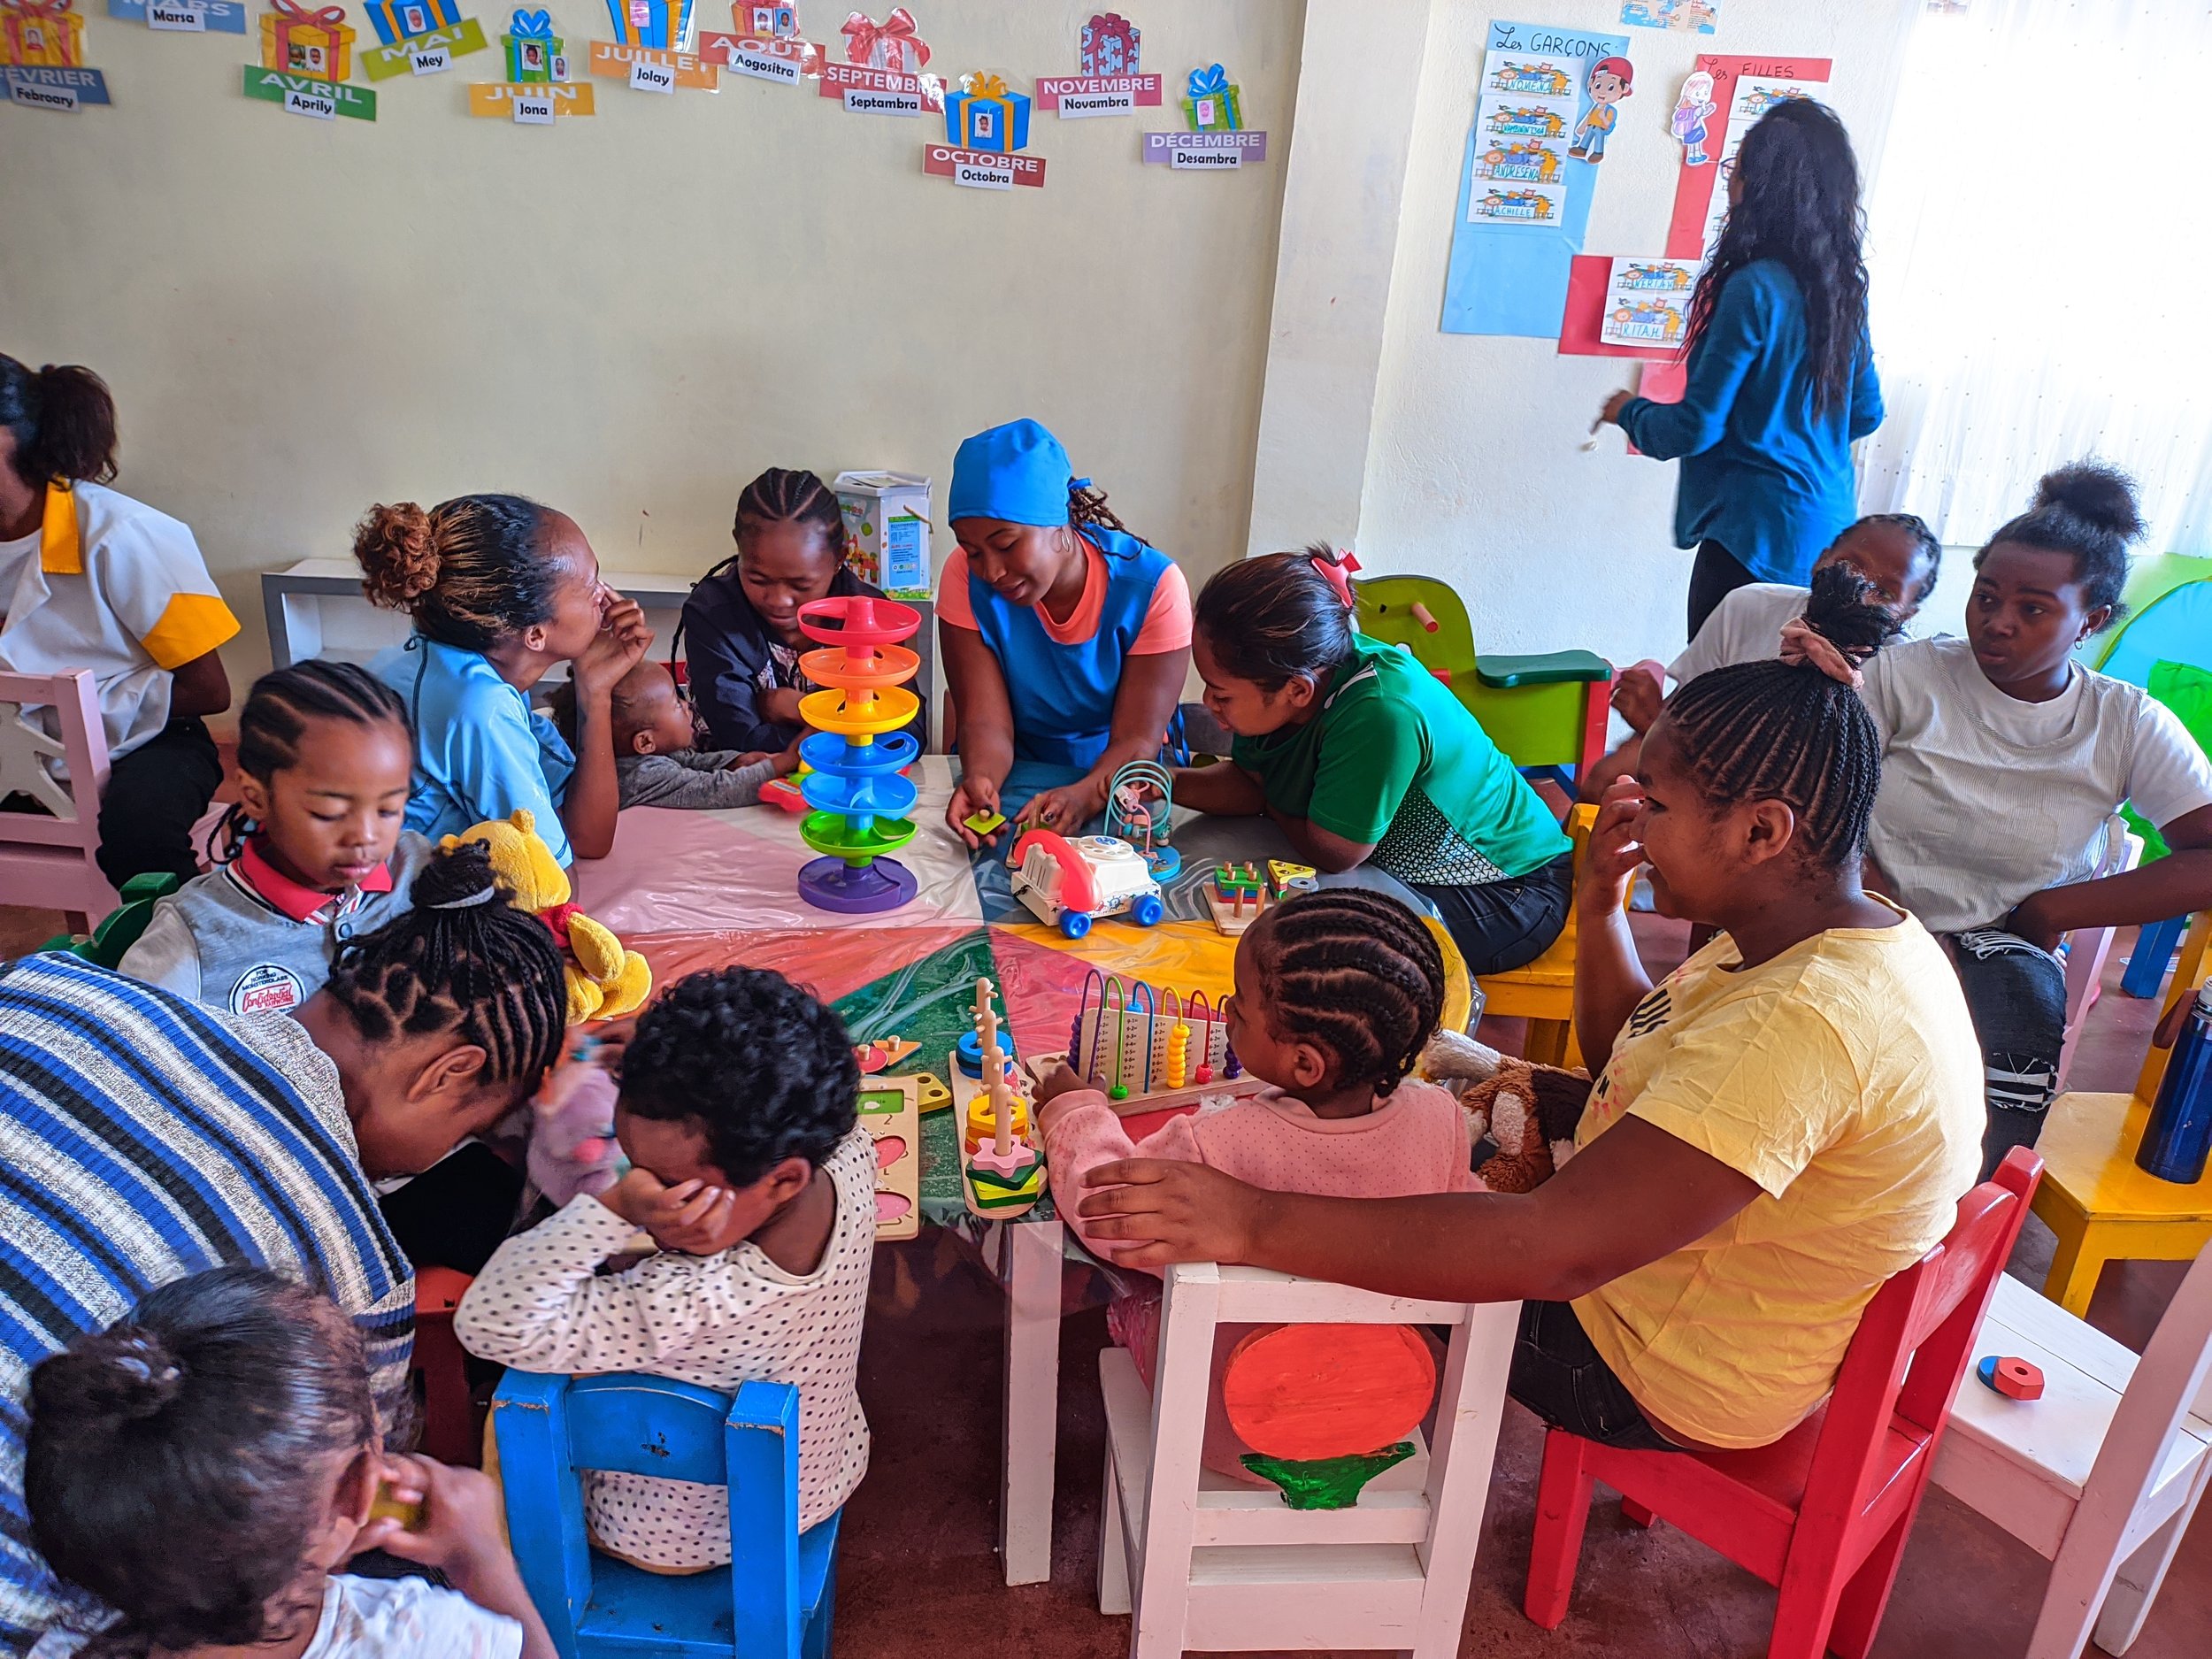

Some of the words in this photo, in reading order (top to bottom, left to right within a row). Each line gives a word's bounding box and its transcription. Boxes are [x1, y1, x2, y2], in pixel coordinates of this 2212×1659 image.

[153, 9, 195, 23] Marsa
[380, 27, 464, 62] MAI
[1494, 23, 1522, 50] Les
[1531, 33, 1610, 58] GARÇONS
[416, 56, 442, 68] Mey
[734, 54, 795, 78] Aogositra
[1701, 57, 1728, 81] Les
[1741, 62, 1794, 78] FILLES
[0, 65, 97, 87] ÉVRIER
[636, 68, 670, 86] Jolay
[260, 73, 363, 104] AVRIL
[485, 86, 578, 100] JUIN
[1043, 78, 1156, 95] NOVEMBRE
[17, 88, 73, 108] Febroary
[291, 95, 332, 115] Aprily
[850, 96, 918, 110] Septambra
[1064, 96, 1129, 110] Novambra
[519, 103, 548, 116] Jona
[1151, 132, 1260, 149] DÉCEMBRE
[932, 148, 1039, 173] OCTOBRE
[1177, 152, 1238, 165] Desambra
[961, 168, 1010, 184] Octobra
[1495, 206, 1531, 216] ACHILLE
[1623, 323, 1660, 338] RITAH
